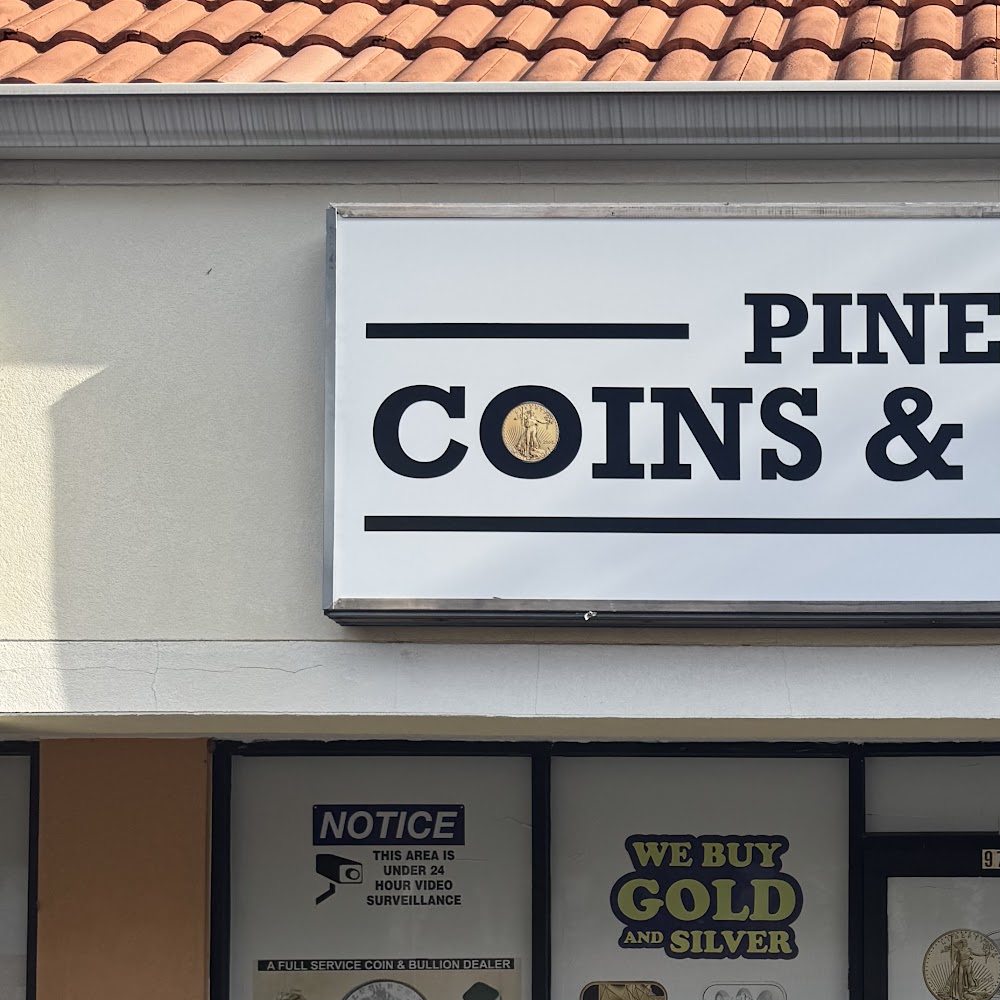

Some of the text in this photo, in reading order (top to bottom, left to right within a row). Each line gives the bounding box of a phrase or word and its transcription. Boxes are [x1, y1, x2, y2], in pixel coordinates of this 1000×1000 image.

[372, 384, 820, 481] COINS
[865, 385, 965, 481] &
[319, 809, 458, 840] NOTICE
[373, 850, 455, 861] THIS AREA IS
[632, 843, 783, 868] WE BUY
[383, 865, 445, 876] UNDER 24
[375, 880, 453, 891] HOUR VIDEO
[367, 895, 462, 906] SURVEILLANCE
[616, 879, 797, 922] GOLD
[623, 929, 792, 955] AND SILVER
[266, 959, 511, 971] A FULL SERVICE COIN & BULLION DEALER
